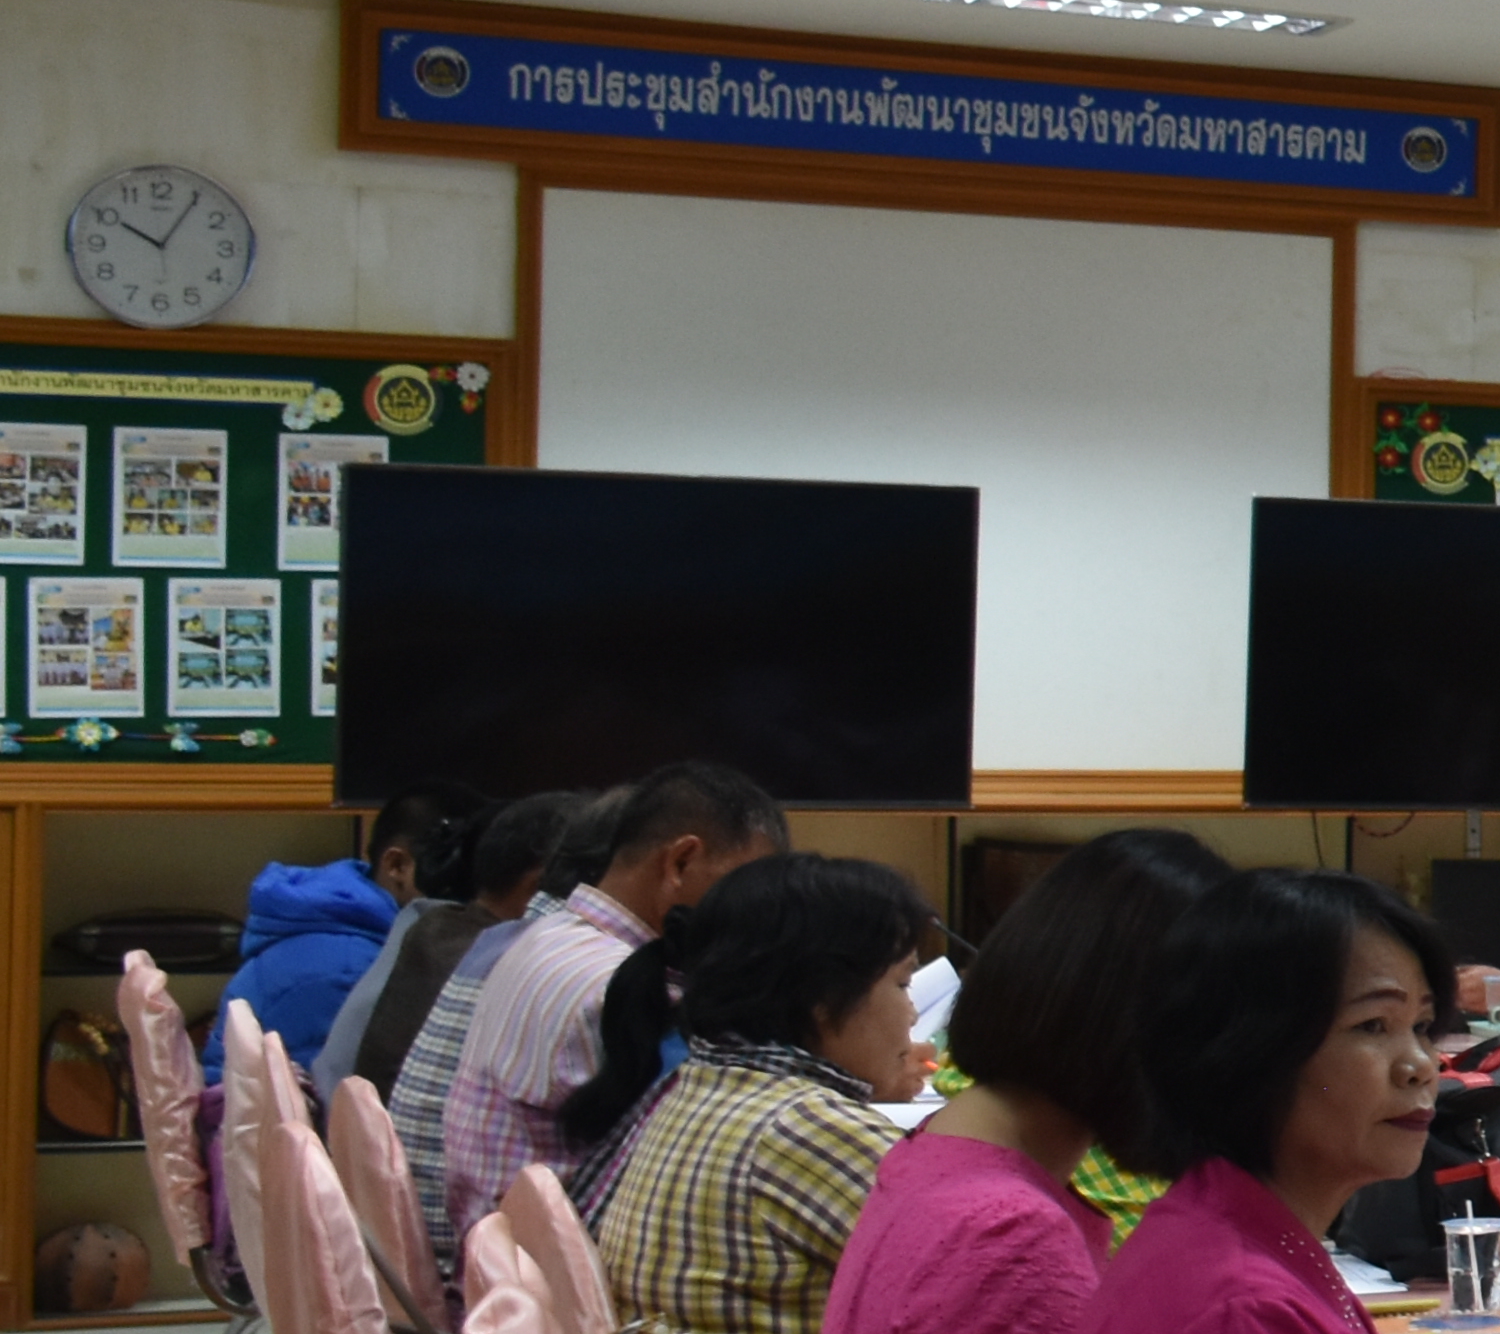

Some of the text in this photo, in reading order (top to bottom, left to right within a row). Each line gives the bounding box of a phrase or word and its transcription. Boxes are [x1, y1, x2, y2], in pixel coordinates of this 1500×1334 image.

[121, 185, 138, 204] 11
[151, 181, 173, 200] 12
[92, 206, 119, 227] 10
[209, 211, 225, 230] 2
[87, 234, 106, 252] 9
[217, 240, 234, 258] 3
[97, 262, 114, 281] 8
[206, 267, 222, 284] 4
[123, 284, 139, 302] 7
[151, 293, 170, 312] 6
[183, 287, 200, 306] 5
